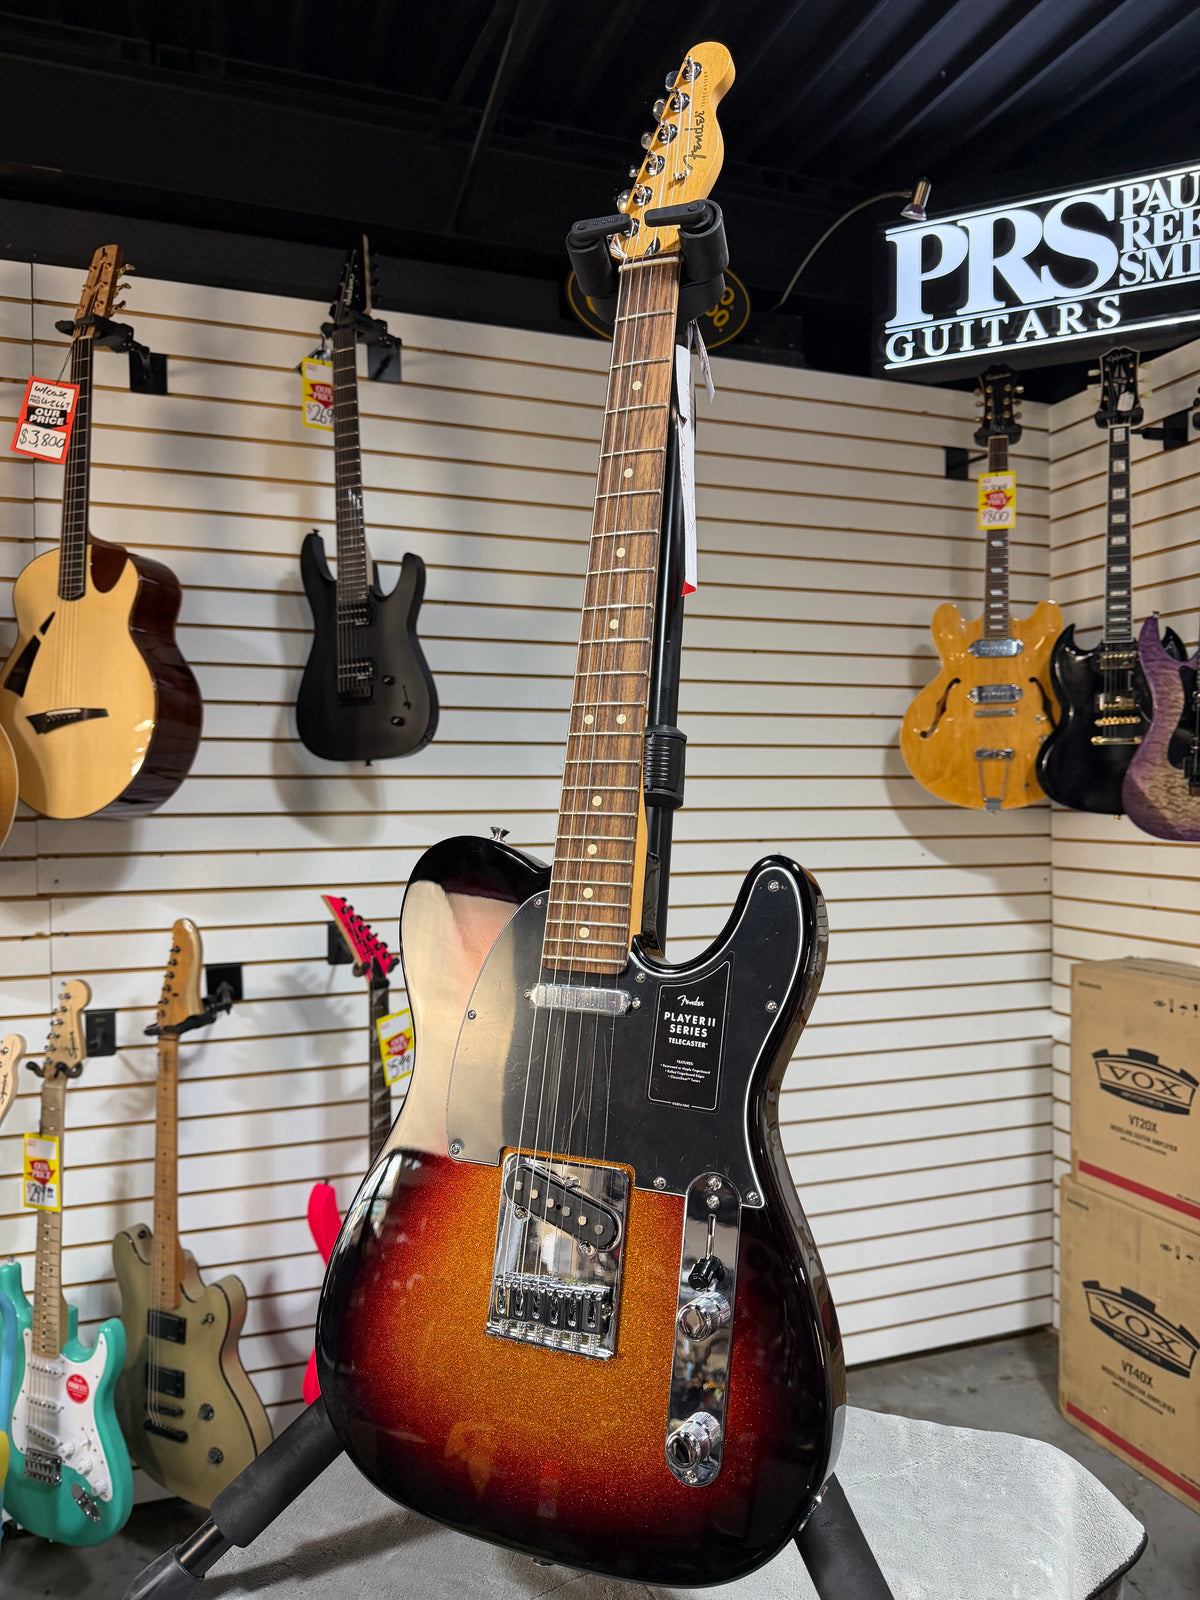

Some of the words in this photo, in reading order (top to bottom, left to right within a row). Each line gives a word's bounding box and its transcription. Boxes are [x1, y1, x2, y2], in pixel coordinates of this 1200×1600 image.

[683, 110, 707, 170] Fender
[886, 187, 1119, 328] PRS
[885, 295, 1121, 363] GUITARS
[29, 415, 65, 425] PRICE
[35, 408, 61, 417] OUR
[19, 428, 66, 448] $3,800
[677, 994, 705, 1006] Fender
[664, 1011, 705, 1026] PLAYER
[707, 1017, 716, 1027] II
[669, 1024, 708, 1038] SERIES
[668, 1037, 706, 1049] TELECASTER
[1106, 1063, 1182, 1099] VOX
[1128, 1114, 1158, 1133] VT20X
[1096, 1296, 1181, 1358] VOX
[1121, 1360, 1153, 1388] VT40X
